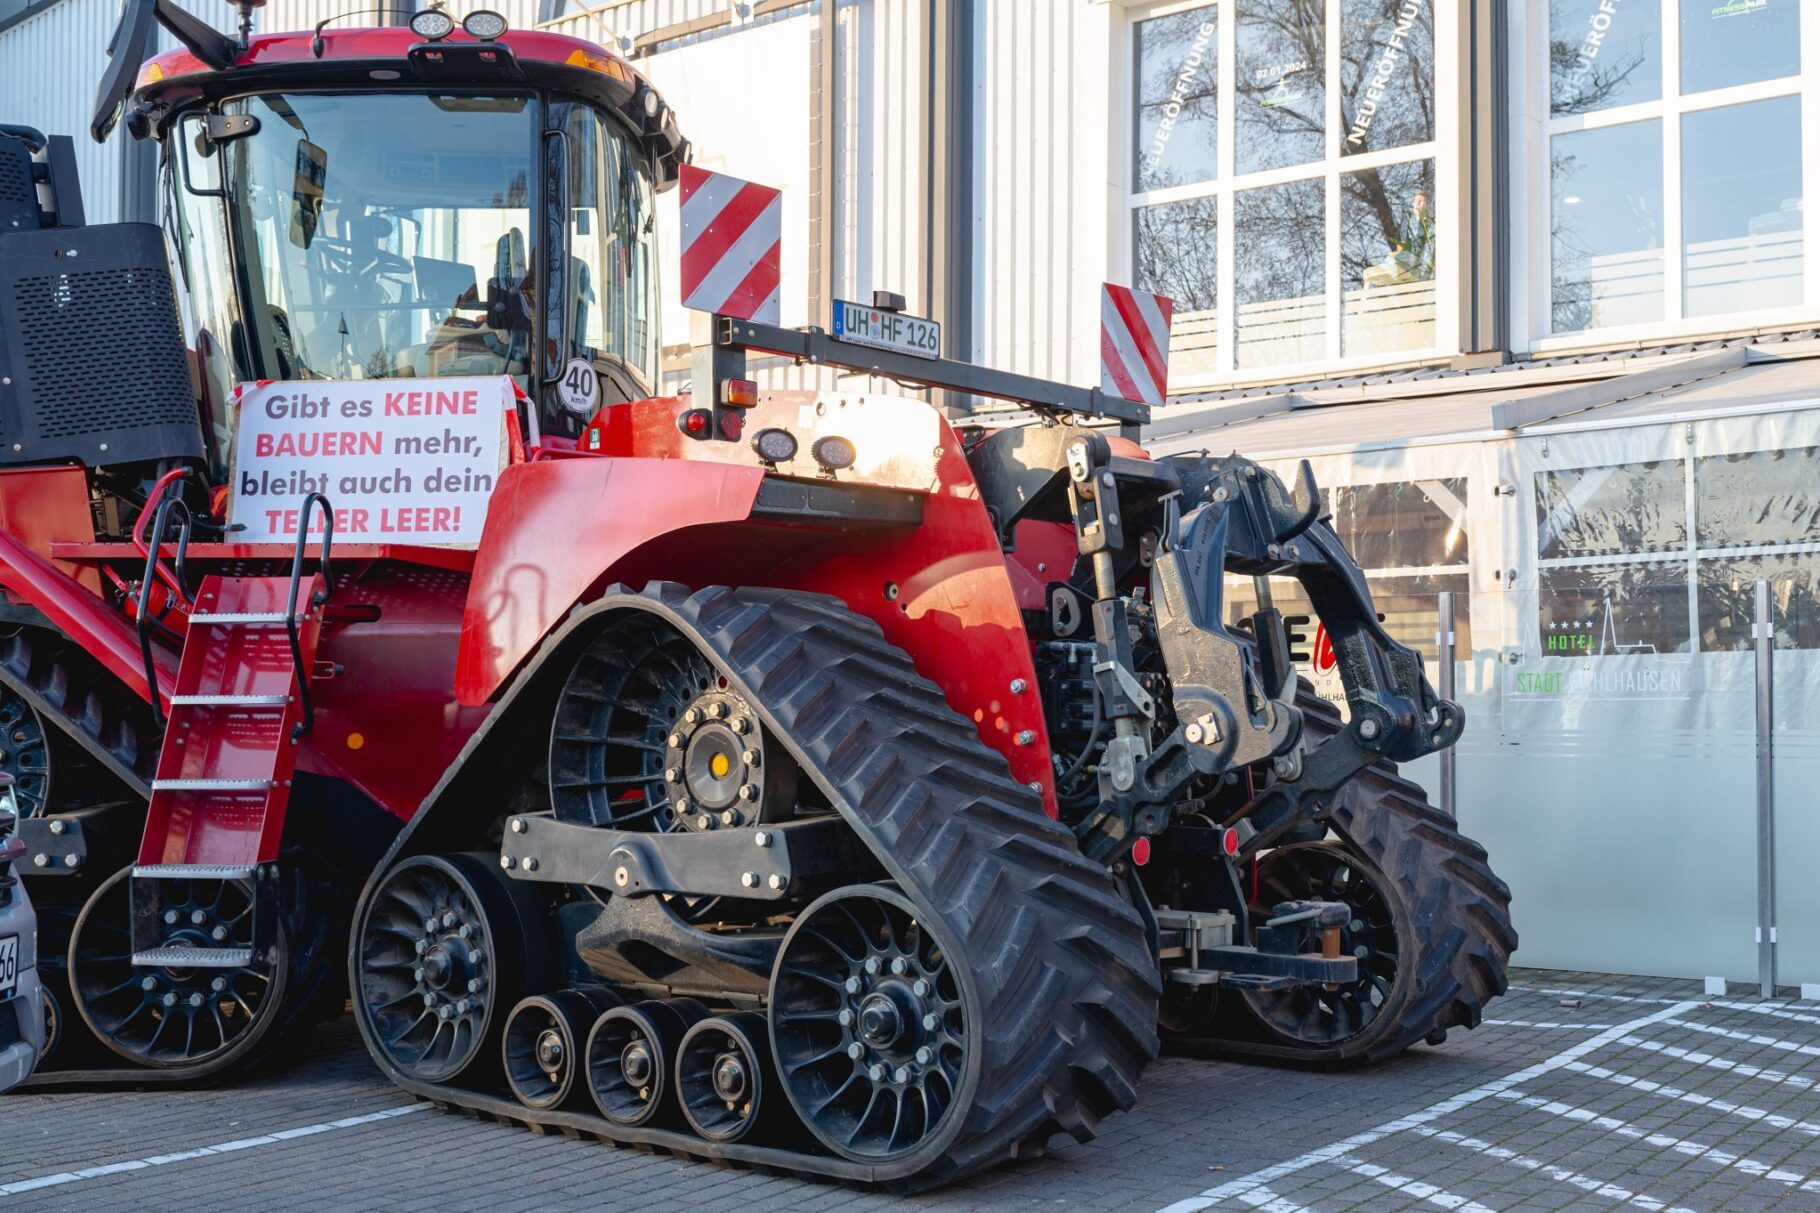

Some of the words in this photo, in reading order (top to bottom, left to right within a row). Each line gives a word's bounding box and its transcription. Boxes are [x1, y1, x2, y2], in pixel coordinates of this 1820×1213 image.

[845, 307, 869, 336] UH
[881, 314, 903, 342] HF
[906, 321, 938, 351] 126
[565, 366, 593, 398] 40
[265, 393, 330, 420] Gibt
[340, 399, 373, 418] es
[384, 390, 478, 416] KEINE
[570, 396, 587, 405] km/h
[255, 431, 383, 457] BAUERN
[394, 428, 482, 458] mehr,
[241, 470, 329, 496] bleibt
[340, 467, 412, 494] auch
[423, 467, 492, 493] dein
[380, 506, 461, 533] LEER!
[1548, 634, 1595, 651] HOTEL
[1516, 671, 1562, 693] STADT
